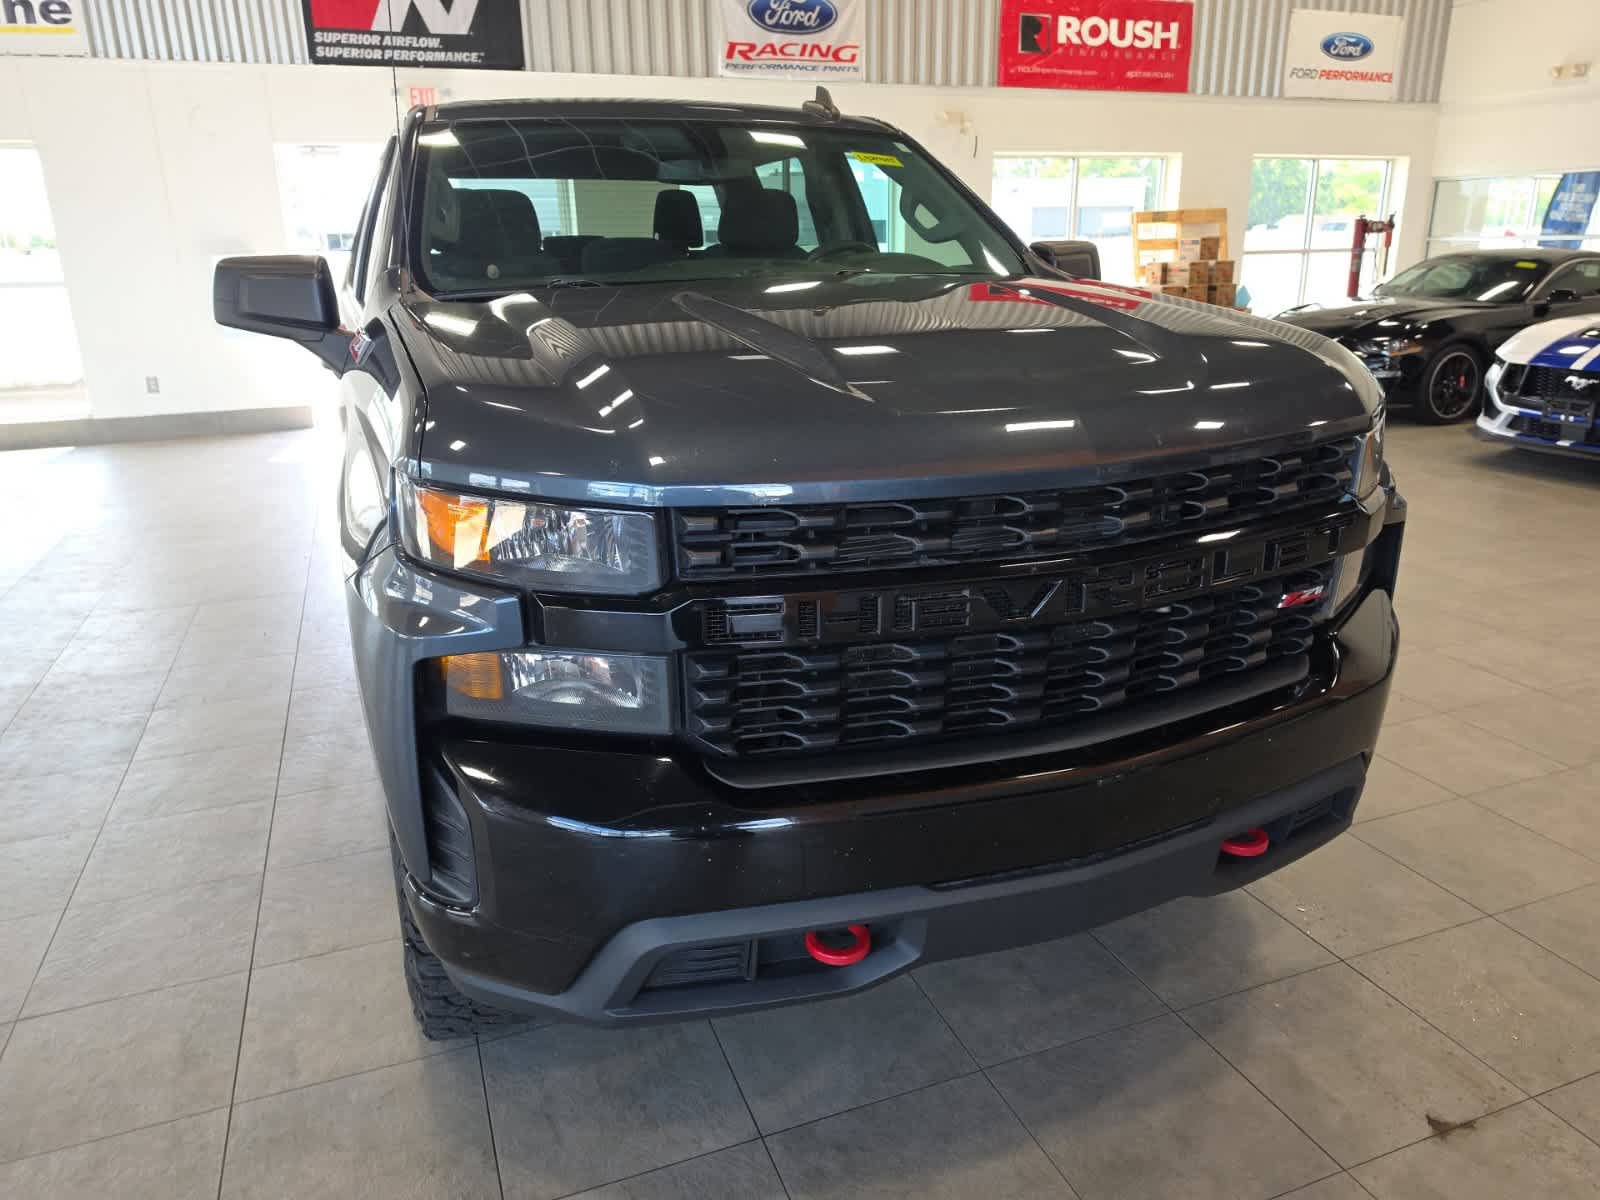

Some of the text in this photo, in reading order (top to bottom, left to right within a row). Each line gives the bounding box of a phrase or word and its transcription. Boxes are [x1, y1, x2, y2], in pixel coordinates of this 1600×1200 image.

[764, 0, 820, 26] Ford
[314, 31, 443, 48] SUPERIOR AIRFLOW.
[1057, 15, 1180, 50] ROUSH
[316, 46, 382, 60] SUPERIOR
[725, 41, 860, 63] RACING
[1329, 35, 1365, 57] Ford
[725, 62, 859, 73] PERFORMANCE PARTS
[1290, 67, 1393, 83] FORD PERFORMANCE
[409, 87, 436, 107] EXIT
[702, 524, 1346, 647] CHEVROLET
